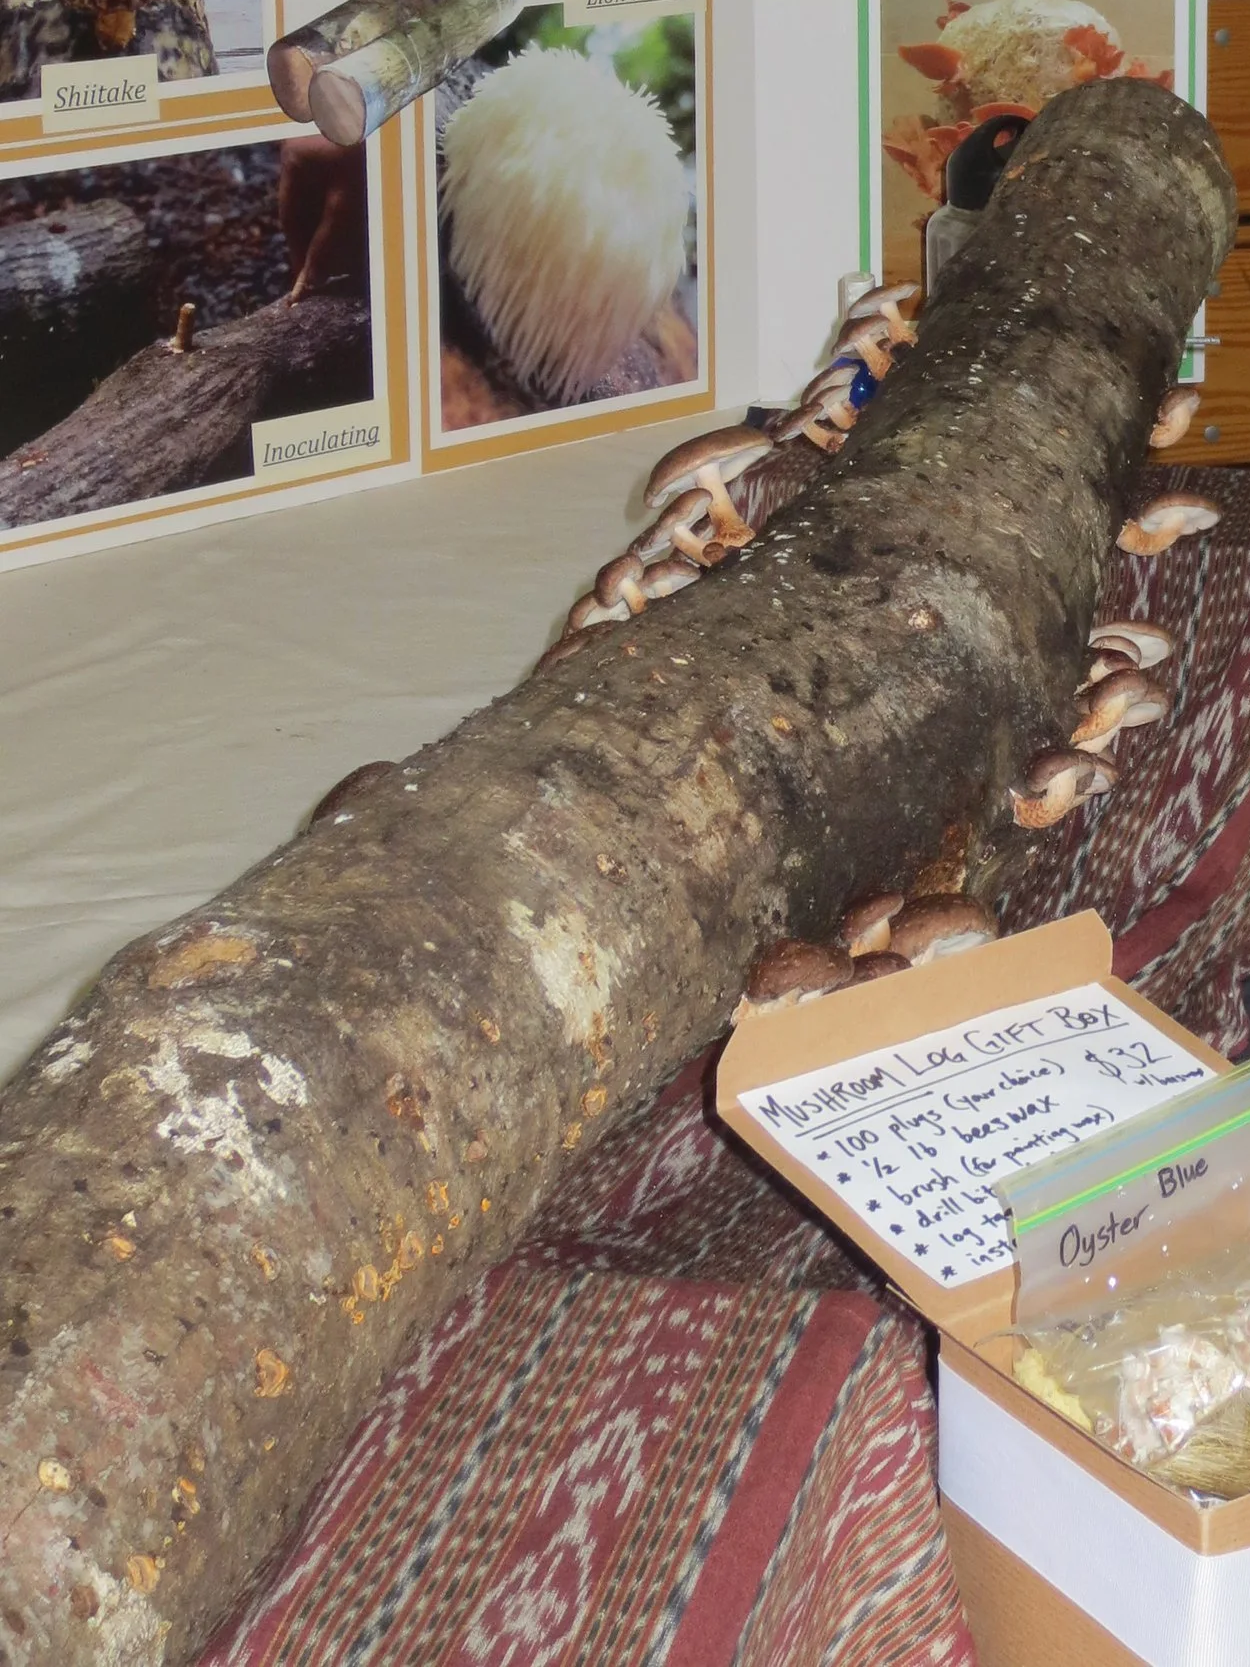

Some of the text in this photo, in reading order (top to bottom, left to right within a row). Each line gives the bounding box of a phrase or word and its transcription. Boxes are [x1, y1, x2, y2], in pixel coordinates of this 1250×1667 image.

[53, 79, 147, 109] Shiitake
[263, 420, 381, 464] Inoculating
[758, 1003, 1122, 1131] MUSHROOM LOG GIFT BOX
[1084, 1041, 1173, 1085] $32
[834, 1129, 880, 1158] 100
[888, 1106, 946, 1142] plugs
[886, 1167, 960, 1206] brush
[1003, 1125, 1082, 1167] painting
[916, 1196, 965, 1228] drill
[1059, 1157, 1208, 1267] Oyster Blue
[938, 1227, 986, 1247] log
